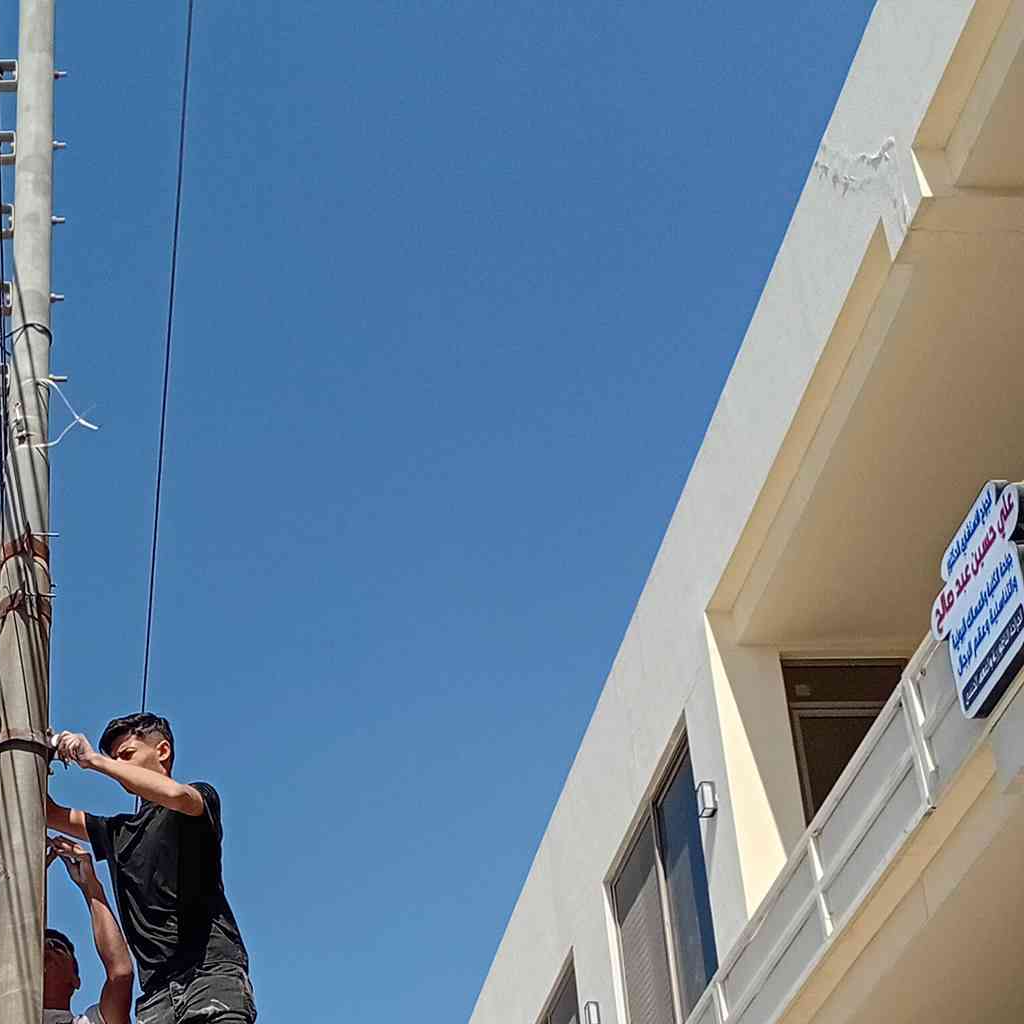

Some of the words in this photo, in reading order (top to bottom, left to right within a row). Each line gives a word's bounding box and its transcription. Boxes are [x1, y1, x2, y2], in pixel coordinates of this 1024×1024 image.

[997, 492, 1014, 540] علي
[971, 526, 997, 577] حسين
[956, 563, 971, 598] عبد
[935, 590, 955, 634] صالح
